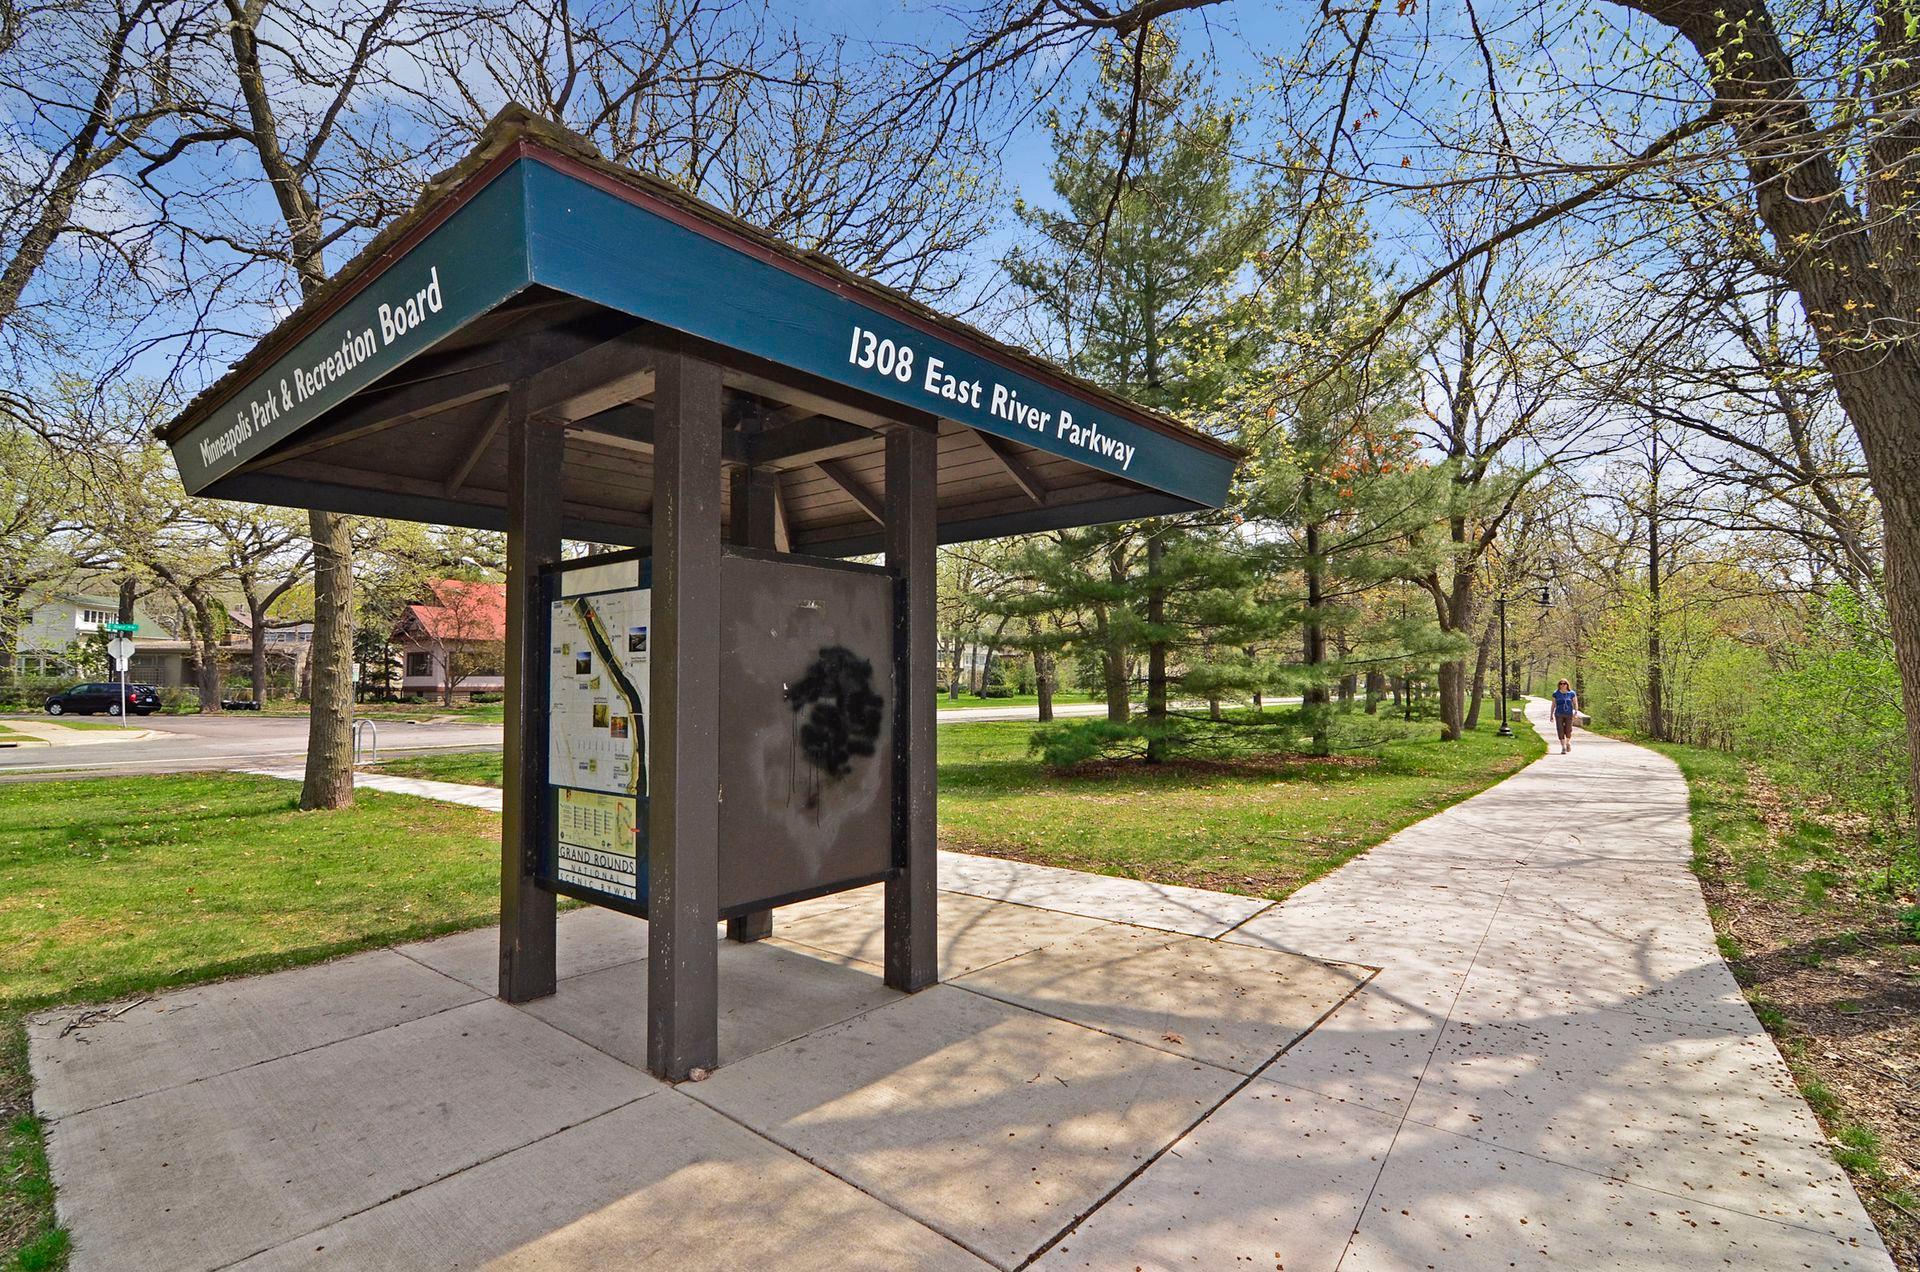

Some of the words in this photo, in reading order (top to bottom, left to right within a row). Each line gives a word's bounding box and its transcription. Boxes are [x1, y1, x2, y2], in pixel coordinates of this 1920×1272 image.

[200, 411, 252, 468] Minneapolis
[250, 389, 280, 432] Park
[280, 378, 294, 412] &
[293, 330, 377, 402] Recreation
[378, 266, 443, 346] Board
[849, 326, 914, 382] 1308
[924, 356, 983, 408] East
[990, 383, 1051, 433] River
[1057, 410, 1136, 471] Parkway
[560, 846, 590, 863] GRAND
[594, 853, 634, 874] ROUNDS
[571, 864, 620, 883] NATIONAL
[560, 872, 593, 888] SCENIC
[600, 883, 634, 898] BYWAY
